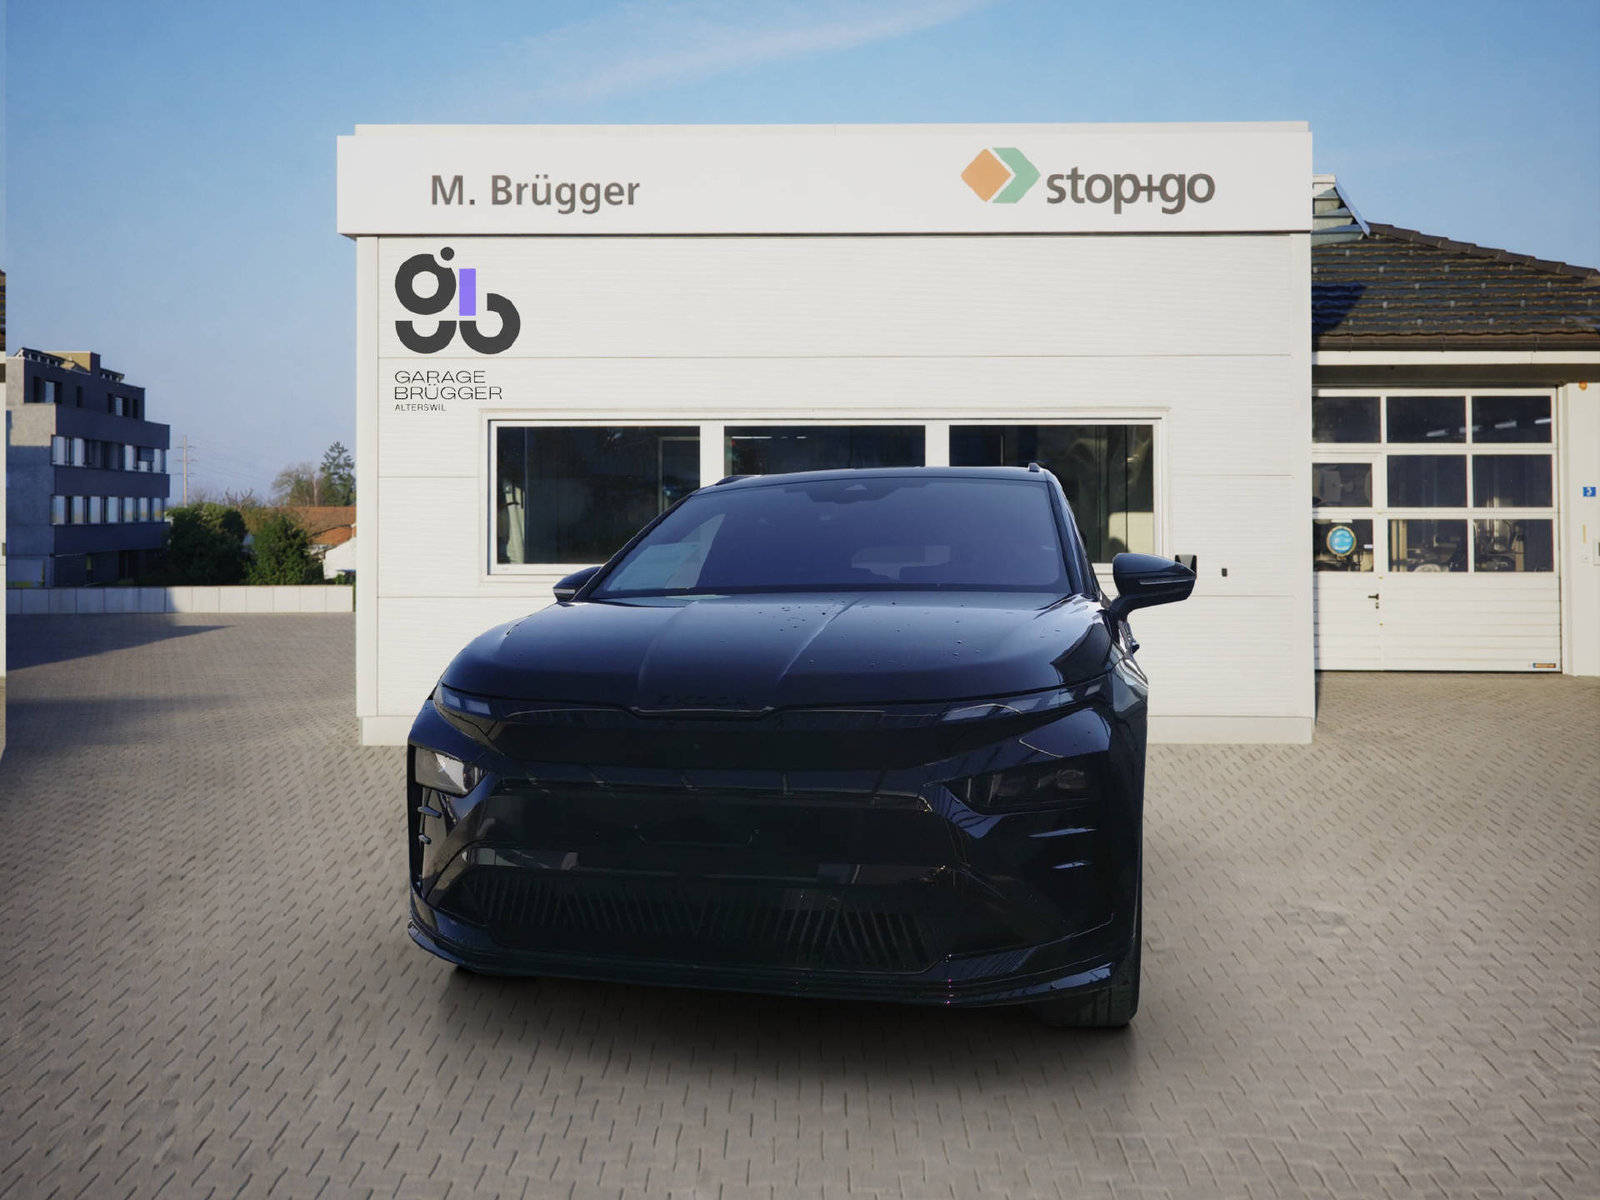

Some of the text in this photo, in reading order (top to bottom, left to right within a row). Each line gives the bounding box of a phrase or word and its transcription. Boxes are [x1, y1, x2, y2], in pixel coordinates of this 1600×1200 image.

[431, 174, 640, 214] M. Brügger
[1046, 167, 1216, 214] stop+go
[394, 371, 486, 383] GARAGE
[394, 384, 503, 400] BRÜGGER
[394, 403, 447, 412] ALTERSWIL
